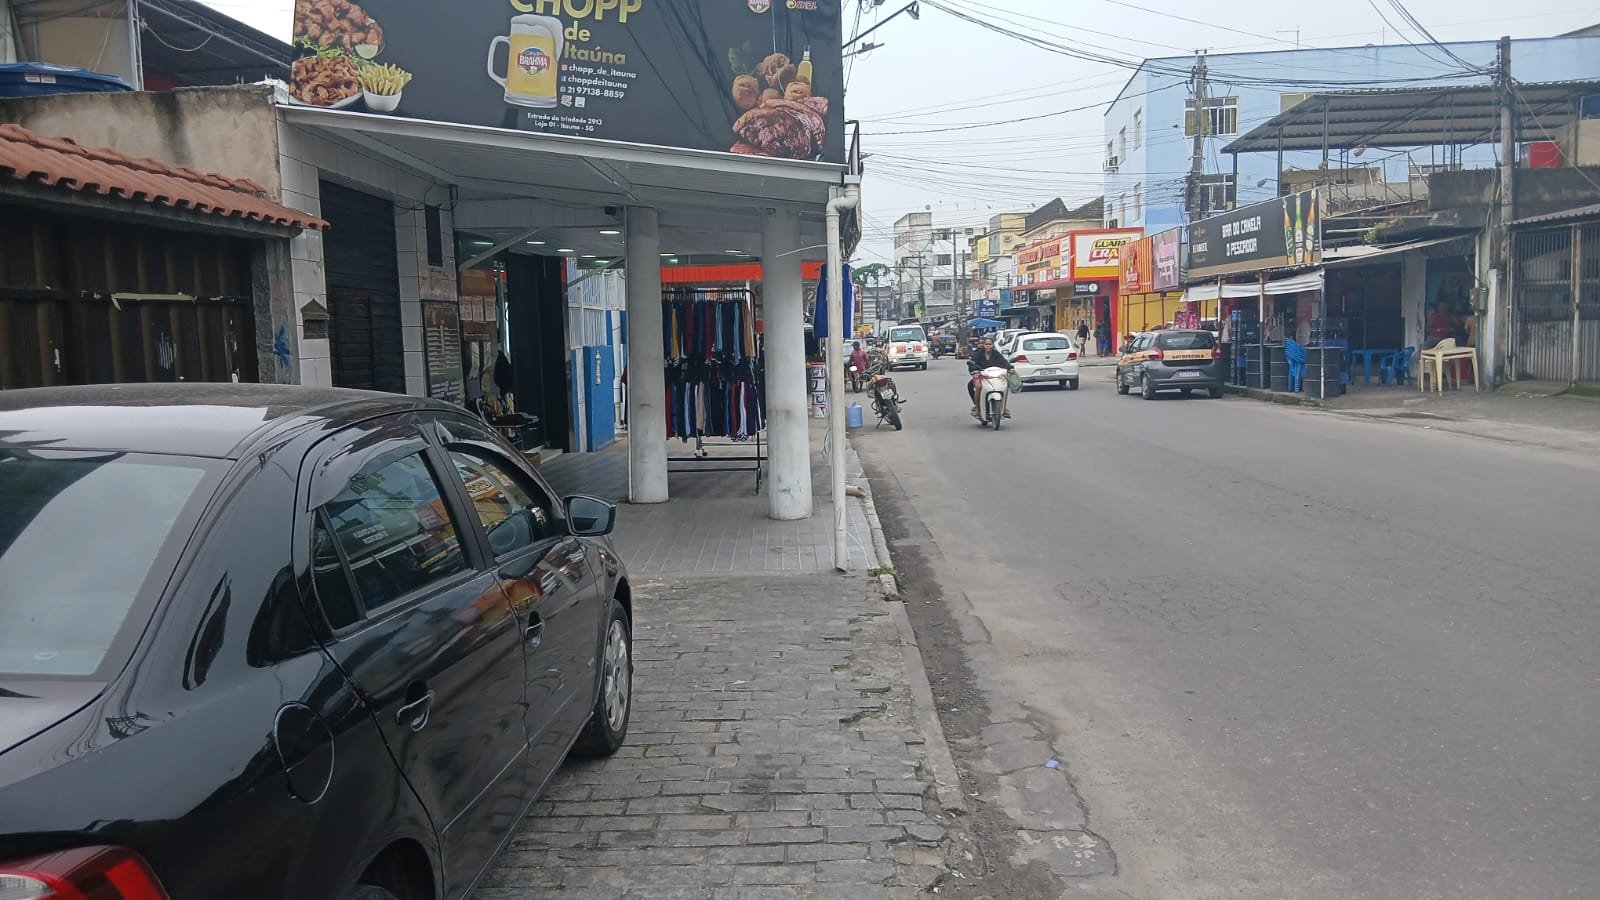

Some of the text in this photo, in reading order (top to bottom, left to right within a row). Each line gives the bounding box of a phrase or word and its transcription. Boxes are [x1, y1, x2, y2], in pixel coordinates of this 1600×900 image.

[510, 0, 642, 23] CHOPP
[564, 21, 591, 42] de
[519, 54, 548, 67] BRAHMA
[564, 42, 626, 65] Itaúna
[568, 63, 637, 79] chopp_de_itauna
[576, 86, 625, 99] 97138-8859
[527, 112, 551, 120] Estrada
[560, 115, 587, 124] trindade
[534, 120, 548, 128] Loja
[1222, 215, 1261, 239] BAR DO CANELA
[1092, 248, 1119, 258] CRA
[1226, 243, 1230, 257] O
[1230, 237, 1258, 257] PESCADOR
